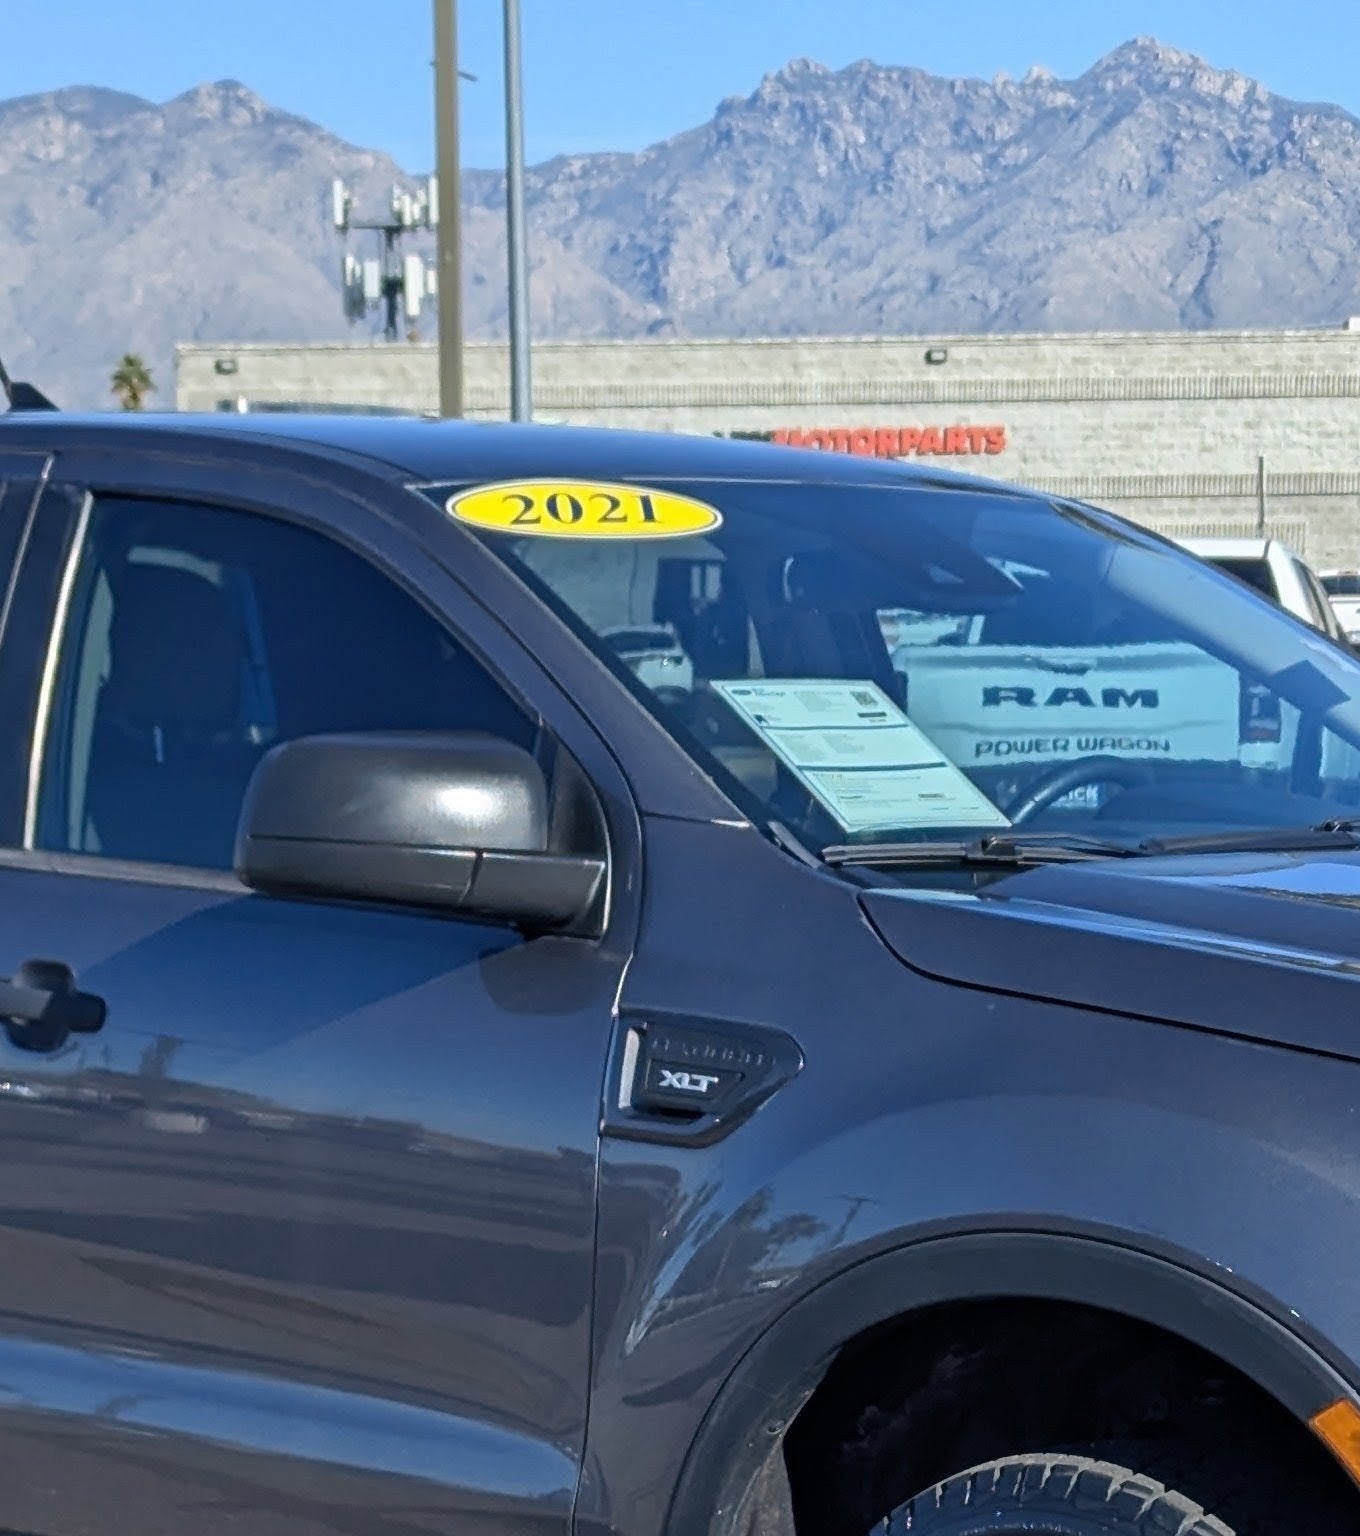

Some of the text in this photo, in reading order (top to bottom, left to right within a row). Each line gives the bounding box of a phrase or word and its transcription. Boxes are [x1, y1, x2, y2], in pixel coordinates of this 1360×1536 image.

[501, 493, 664, 525] 2021
[981, 686, 1160, 709] RAM
[974, 737, 1171, 758] POWER WAGON
[657, 1068, 720, 1093] XLT
